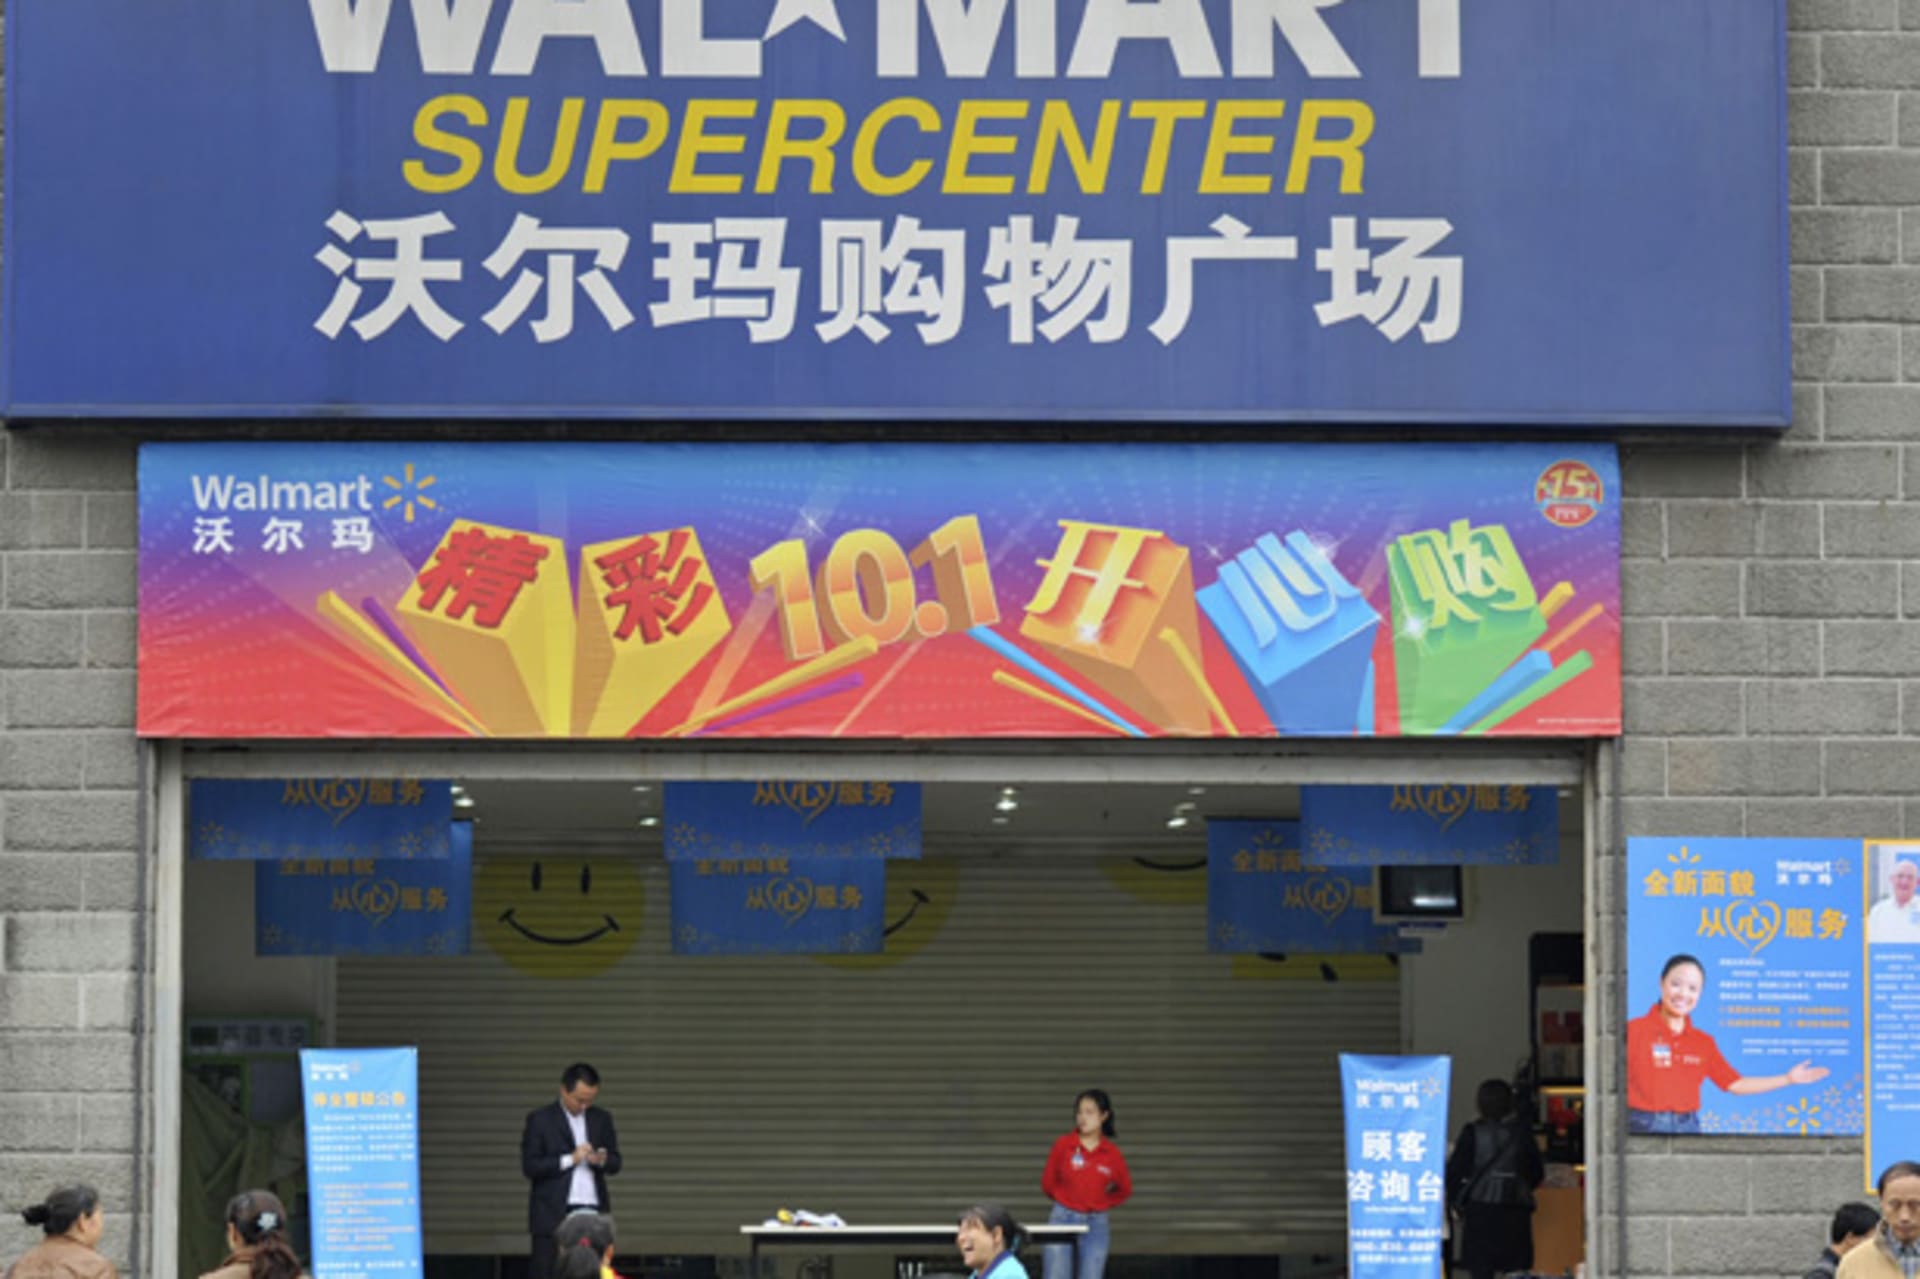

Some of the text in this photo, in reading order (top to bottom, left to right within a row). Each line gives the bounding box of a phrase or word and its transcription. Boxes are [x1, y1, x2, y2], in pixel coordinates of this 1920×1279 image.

[402, 93, 1375, 196] SUPERCENTER
[313, 210, 1464, 345] 沃尔玛购物广场
[192, 474, 372, 511] Walmart
[192, 516, 374, 554] 沃尔玛
[1643, 869, 1756, 897] 全新面貌
[1697, 905, 1848, 940] 从心服务
[1361, 1130, 1428, 1162] 顾客
[1347, 1169, 1444, 1202] 咨询台
